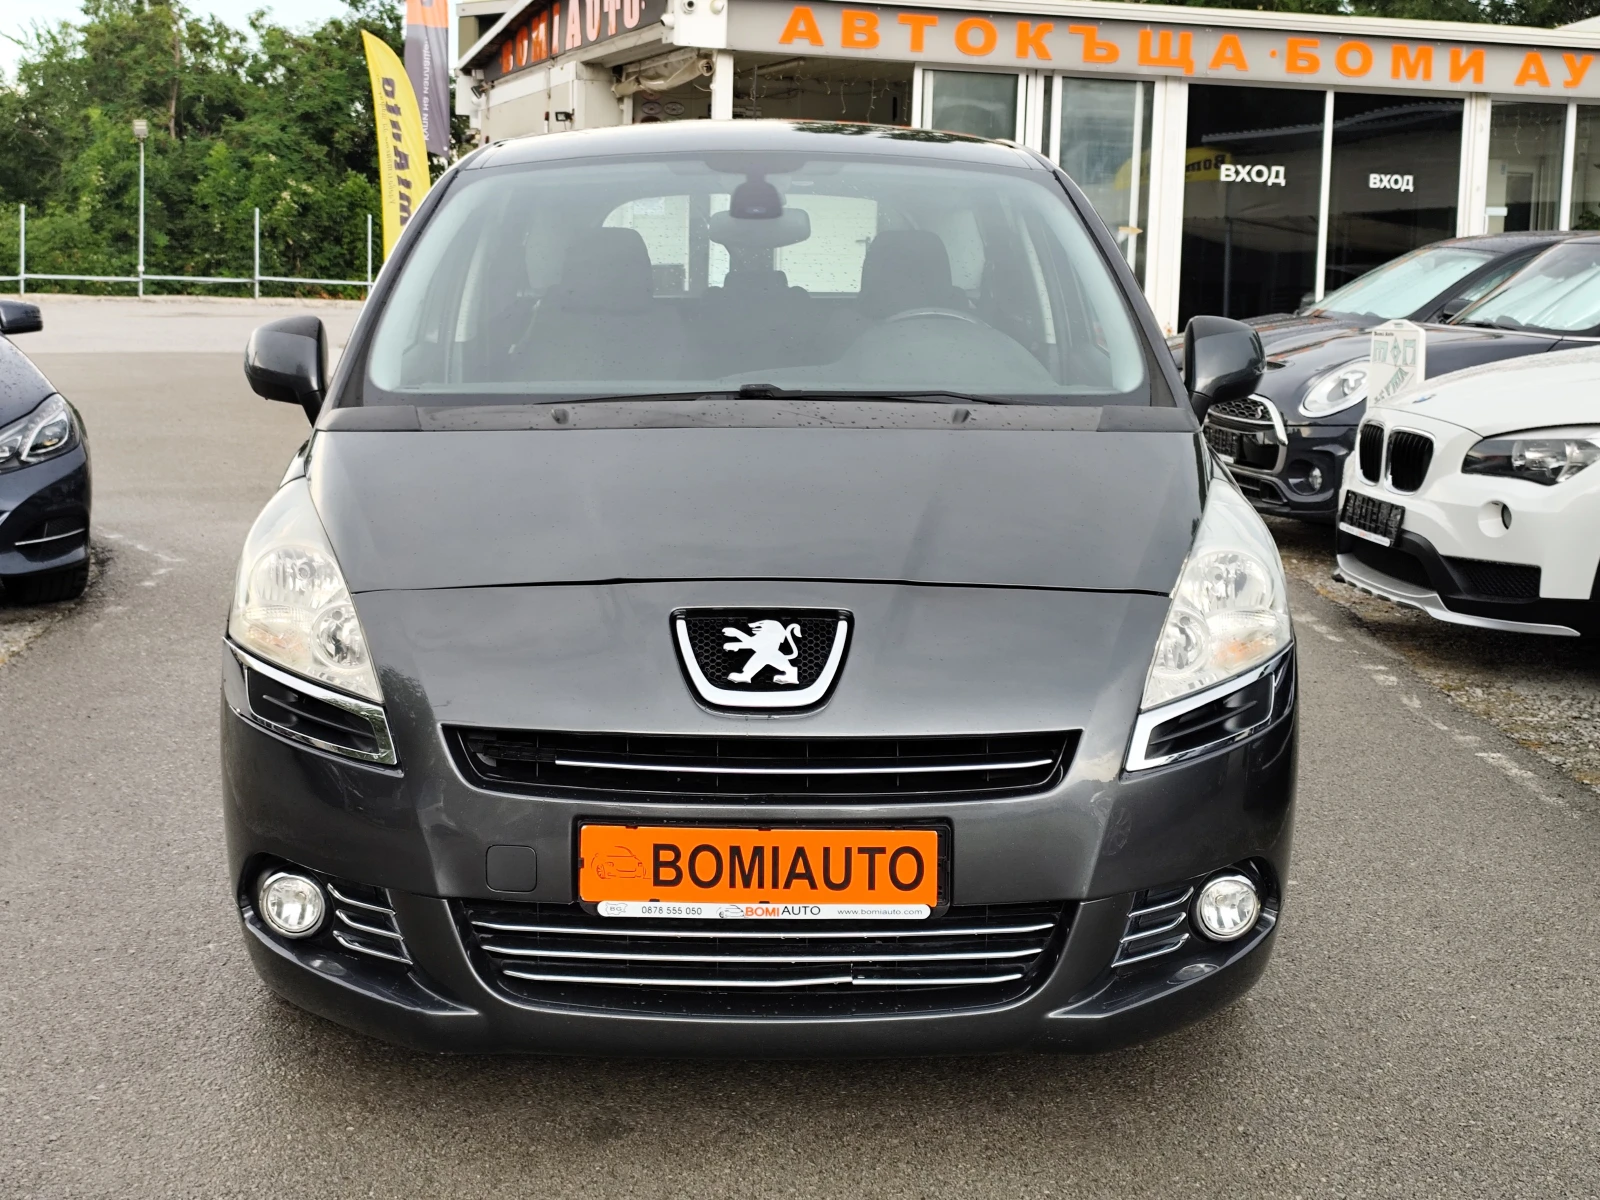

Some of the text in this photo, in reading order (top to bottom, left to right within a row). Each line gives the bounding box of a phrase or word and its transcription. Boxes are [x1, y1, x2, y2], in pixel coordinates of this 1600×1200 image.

[1285, 38, 1486, 85] БОМИ
[1514, 51, 1595, 89] АУ
[1220, 164, 1286, 187] ВХОД
[1369, 173, 1414, 193] ВХОД
[652, 843, 925, 891] BOMIAUTO
[641, 905, 703, 915] 0878 555 050
[837, 908, 923, 916] www.bomiauto.com
